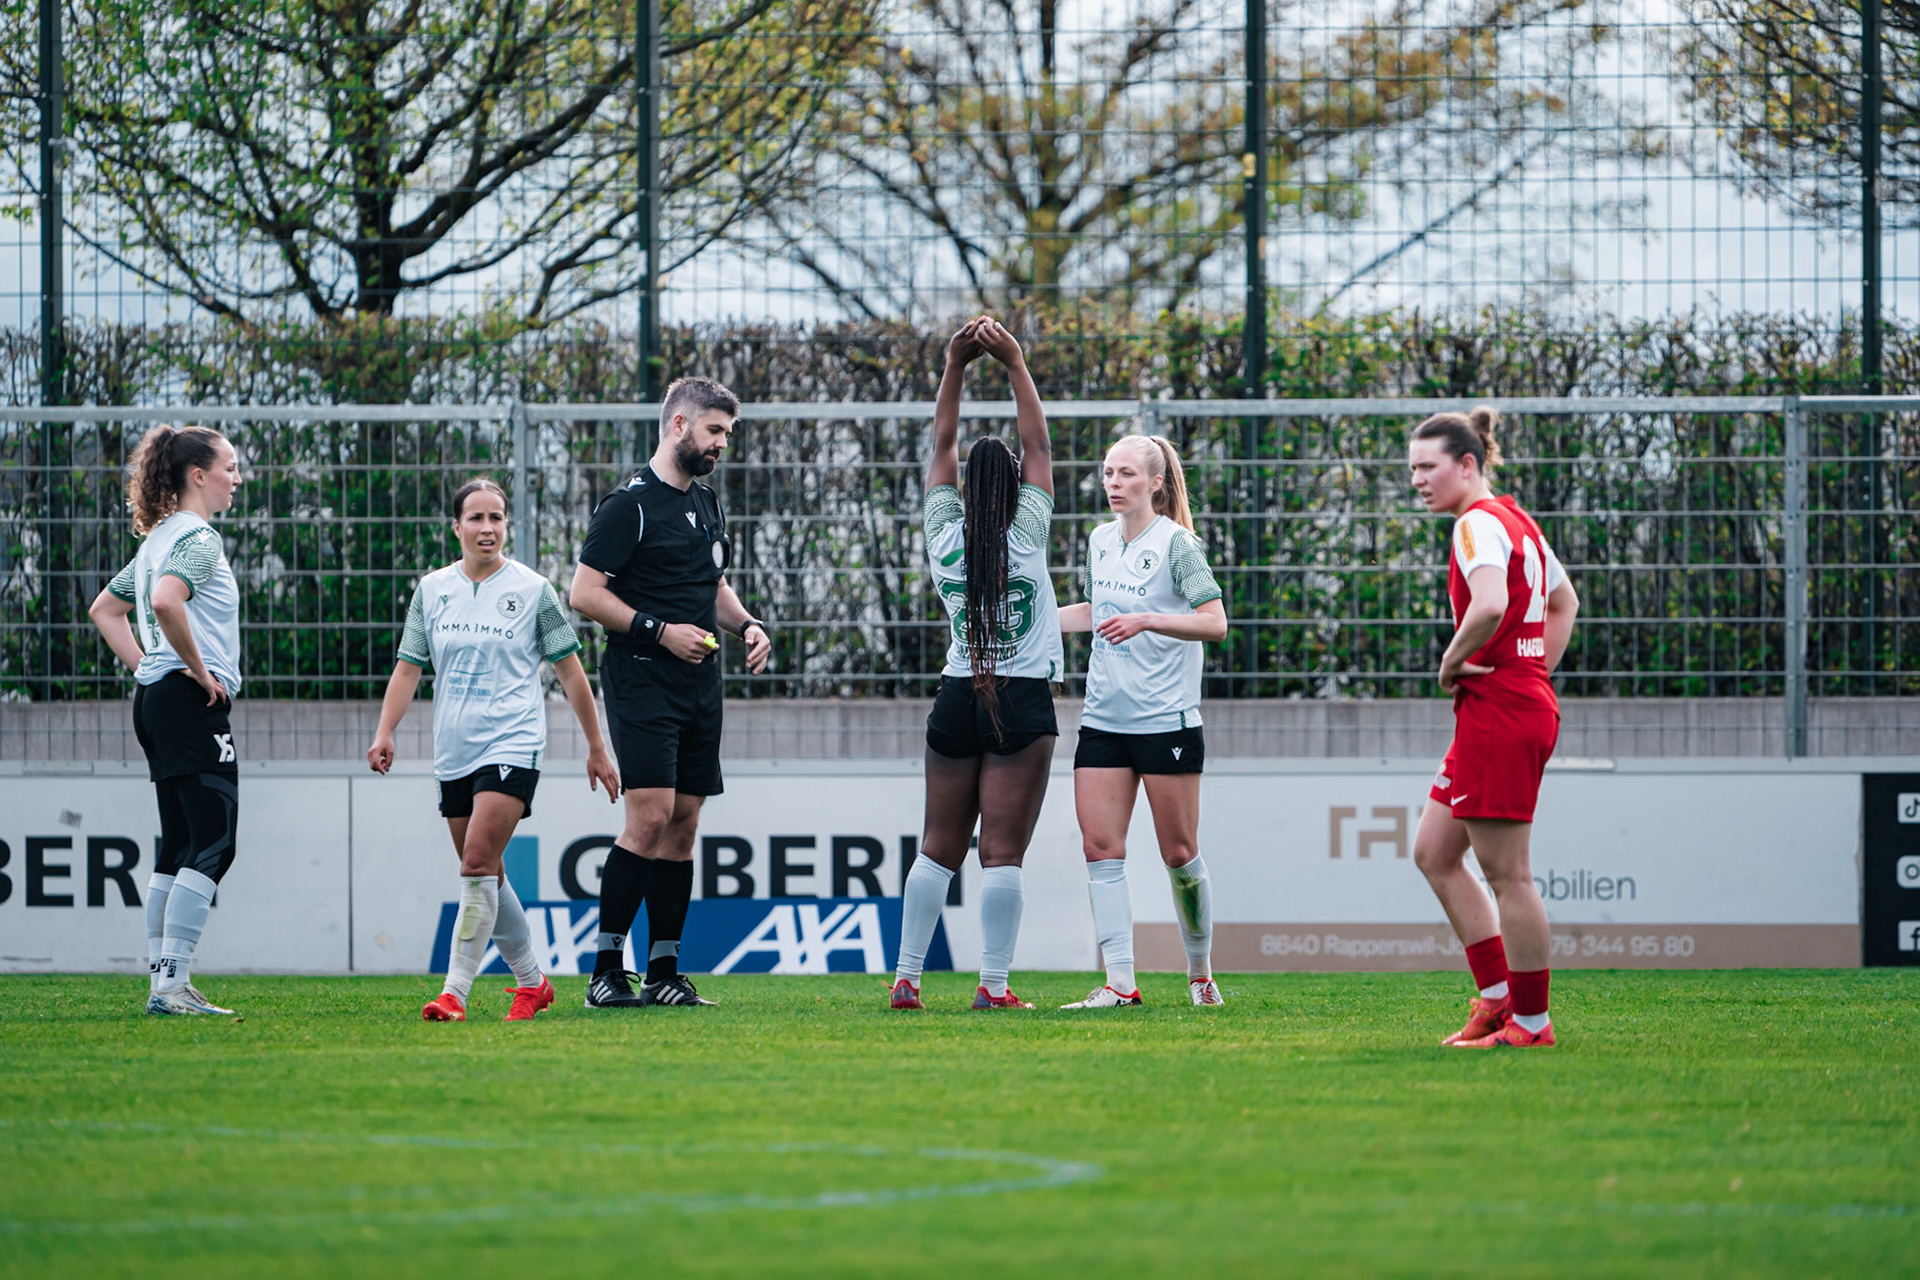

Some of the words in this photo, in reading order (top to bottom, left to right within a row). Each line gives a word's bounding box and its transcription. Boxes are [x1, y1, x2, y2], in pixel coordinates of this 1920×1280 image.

[711, 904, 888, 975] AXA
[1260, 934, 1320, 957] 8640
[1551, 934, 1578, 957] 79
[1581, 934, 1625, 957] 344
[1629, 934, 1660, 957] 95
[1663, 934, 1695, 957] 80
